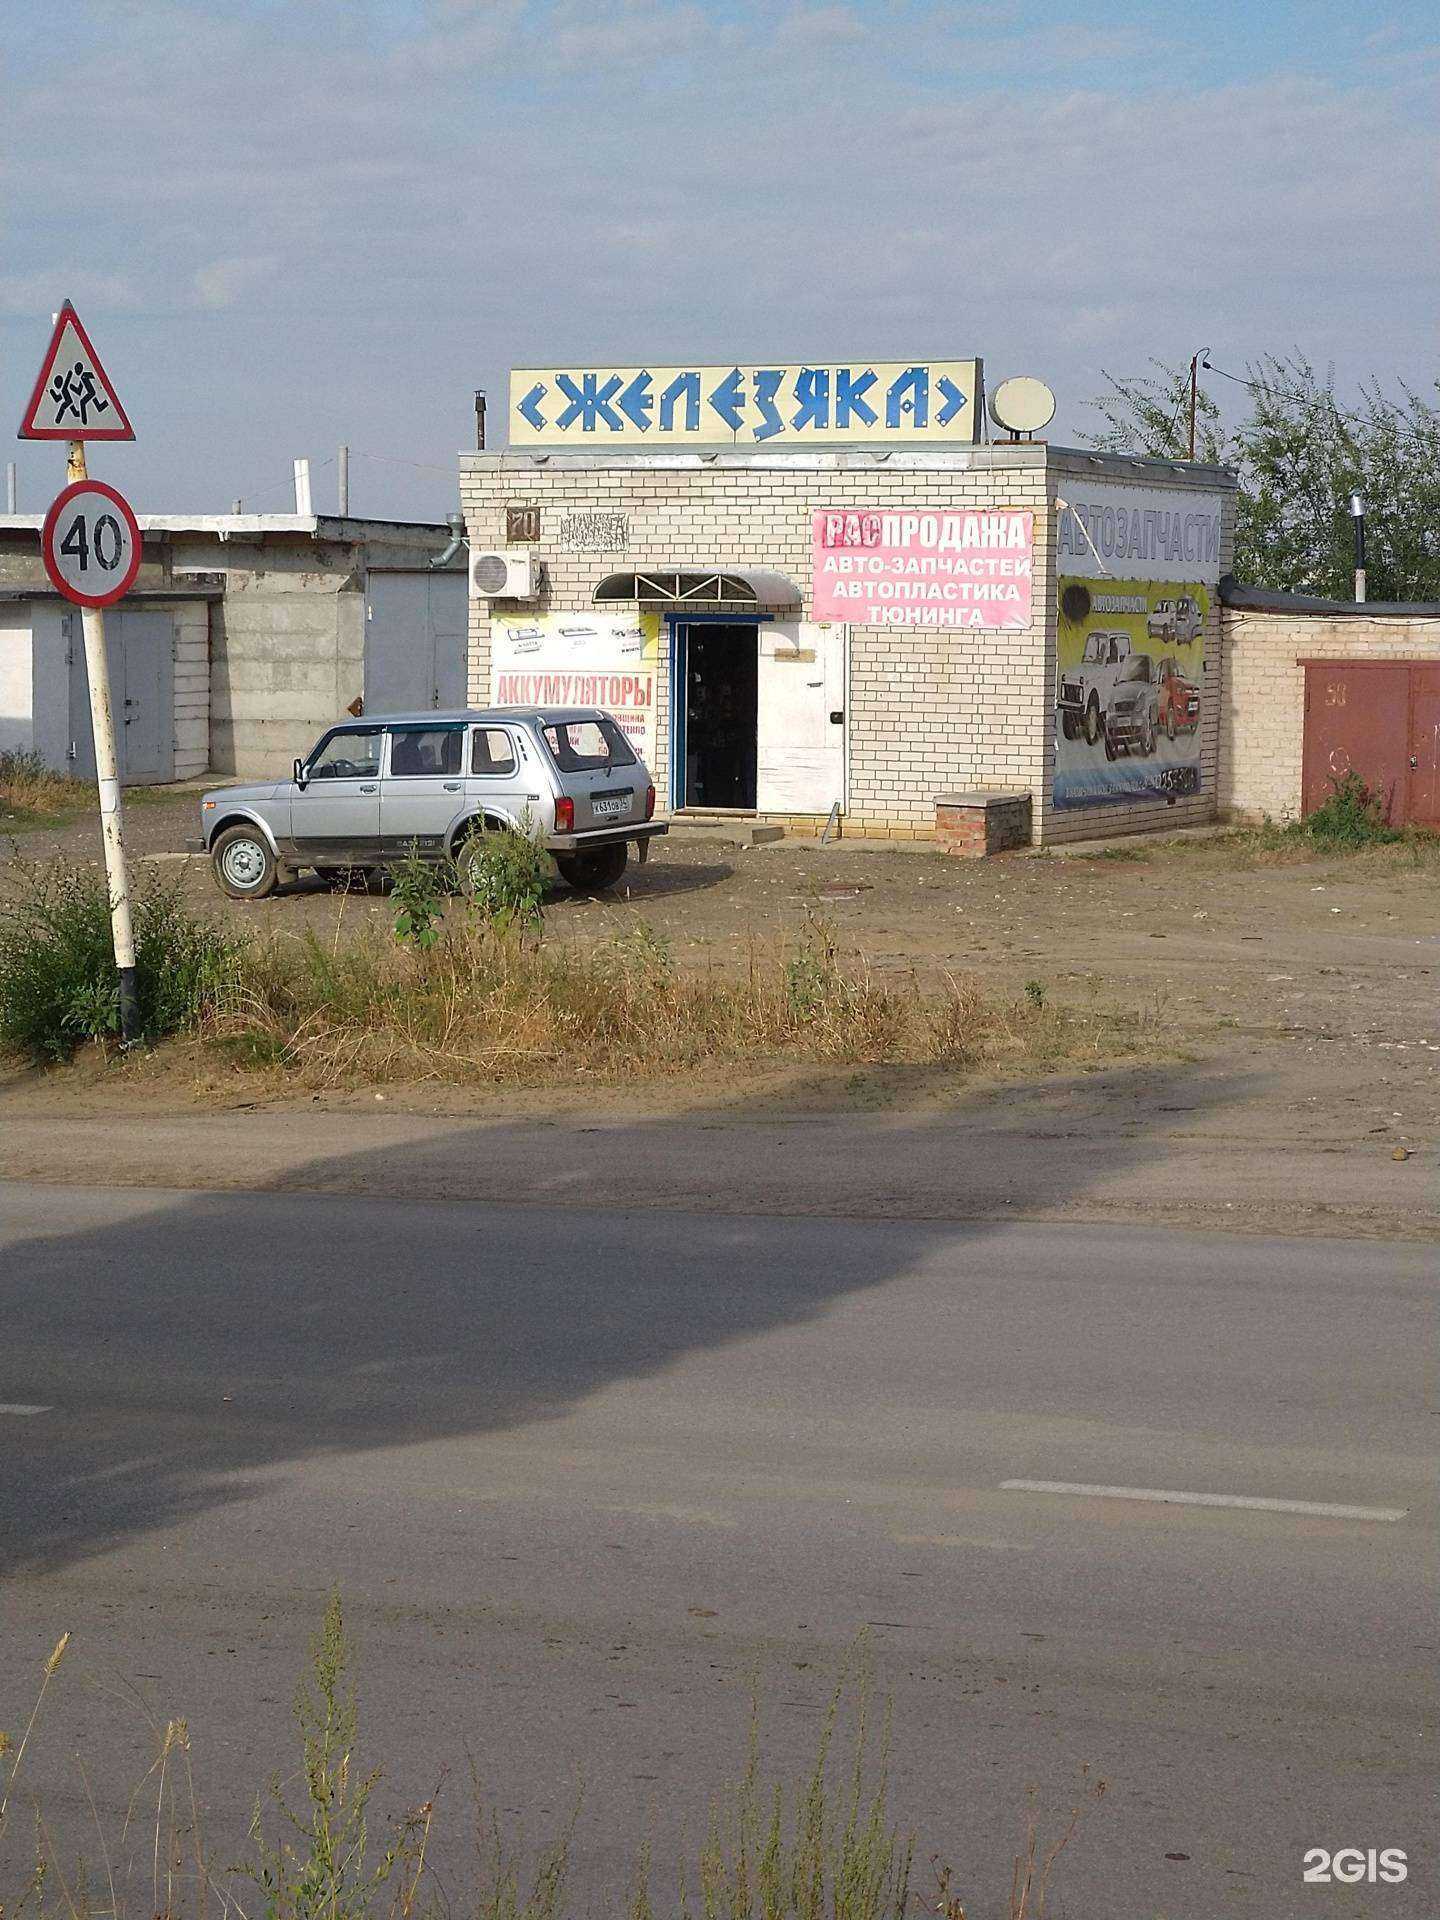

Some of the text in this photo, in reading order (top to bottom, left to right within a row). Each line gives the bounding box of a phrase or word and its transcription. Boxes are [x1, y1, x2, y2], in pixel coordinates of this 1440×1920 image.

[60, 514, 123, 571] 40
[825, 513, 1026, 552] РАСПРОДАЖА
[1057, 503, 1219, 562] АВТОЗАПЧАСТИ
[823, 555, 1032, 577] АВТО-ЗАПЧАСТЕЙ
[832, 581, 1021, 601] АВТОПЛАСТИКА
[867, 605, 984, 625] ТЮНИНГА
[497, 675, 652, 706] АККУМУЛЯТОРЫ
